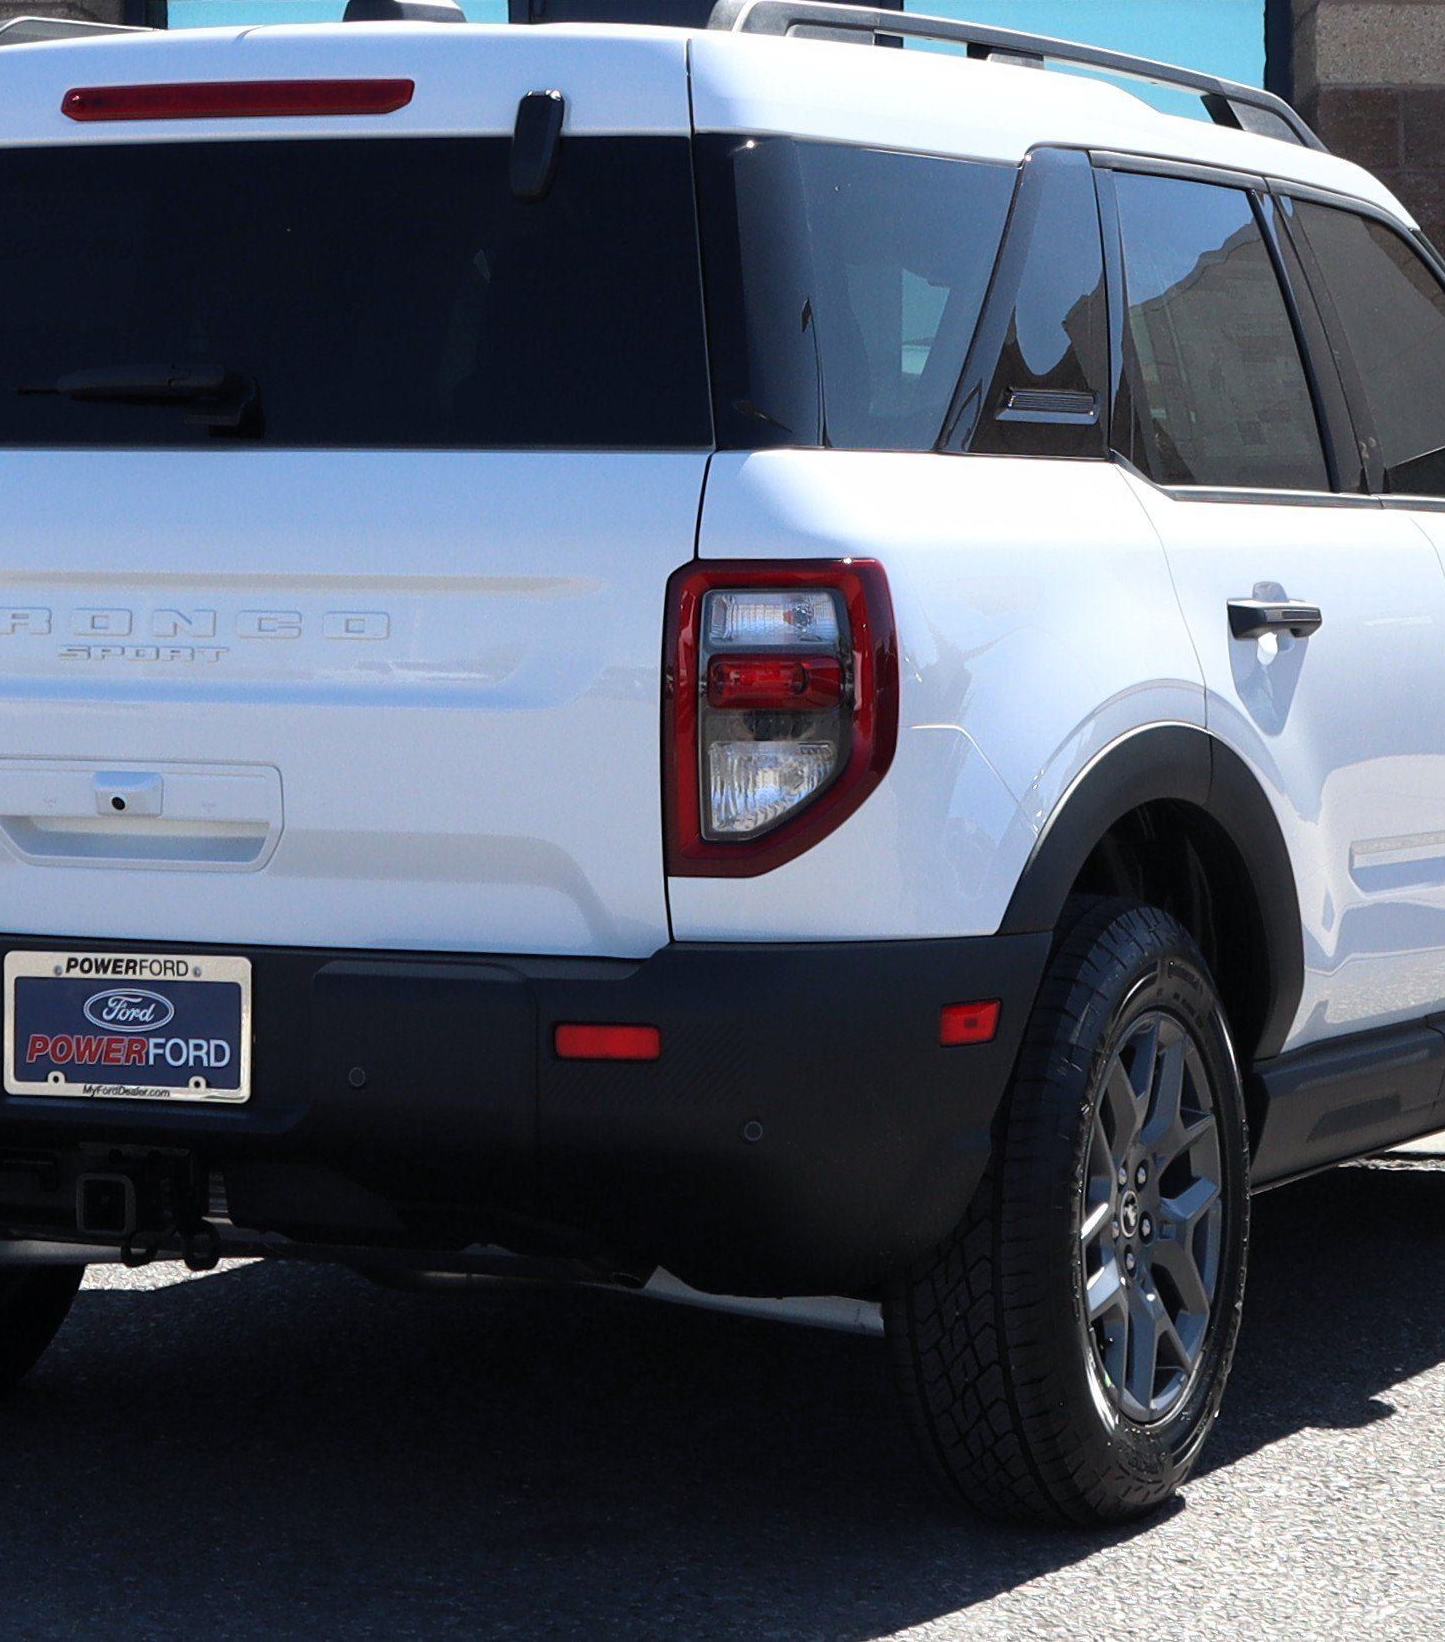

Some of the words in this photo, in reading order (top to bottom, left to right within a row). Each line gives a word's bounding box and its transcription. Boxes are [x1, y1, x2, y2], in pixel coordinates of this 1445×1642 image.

[58, 644, 230, 663] SPORT
[102, 996, 155, 1023] Ford
[82, 1084, 171, 1098] MyFordDealer.com
